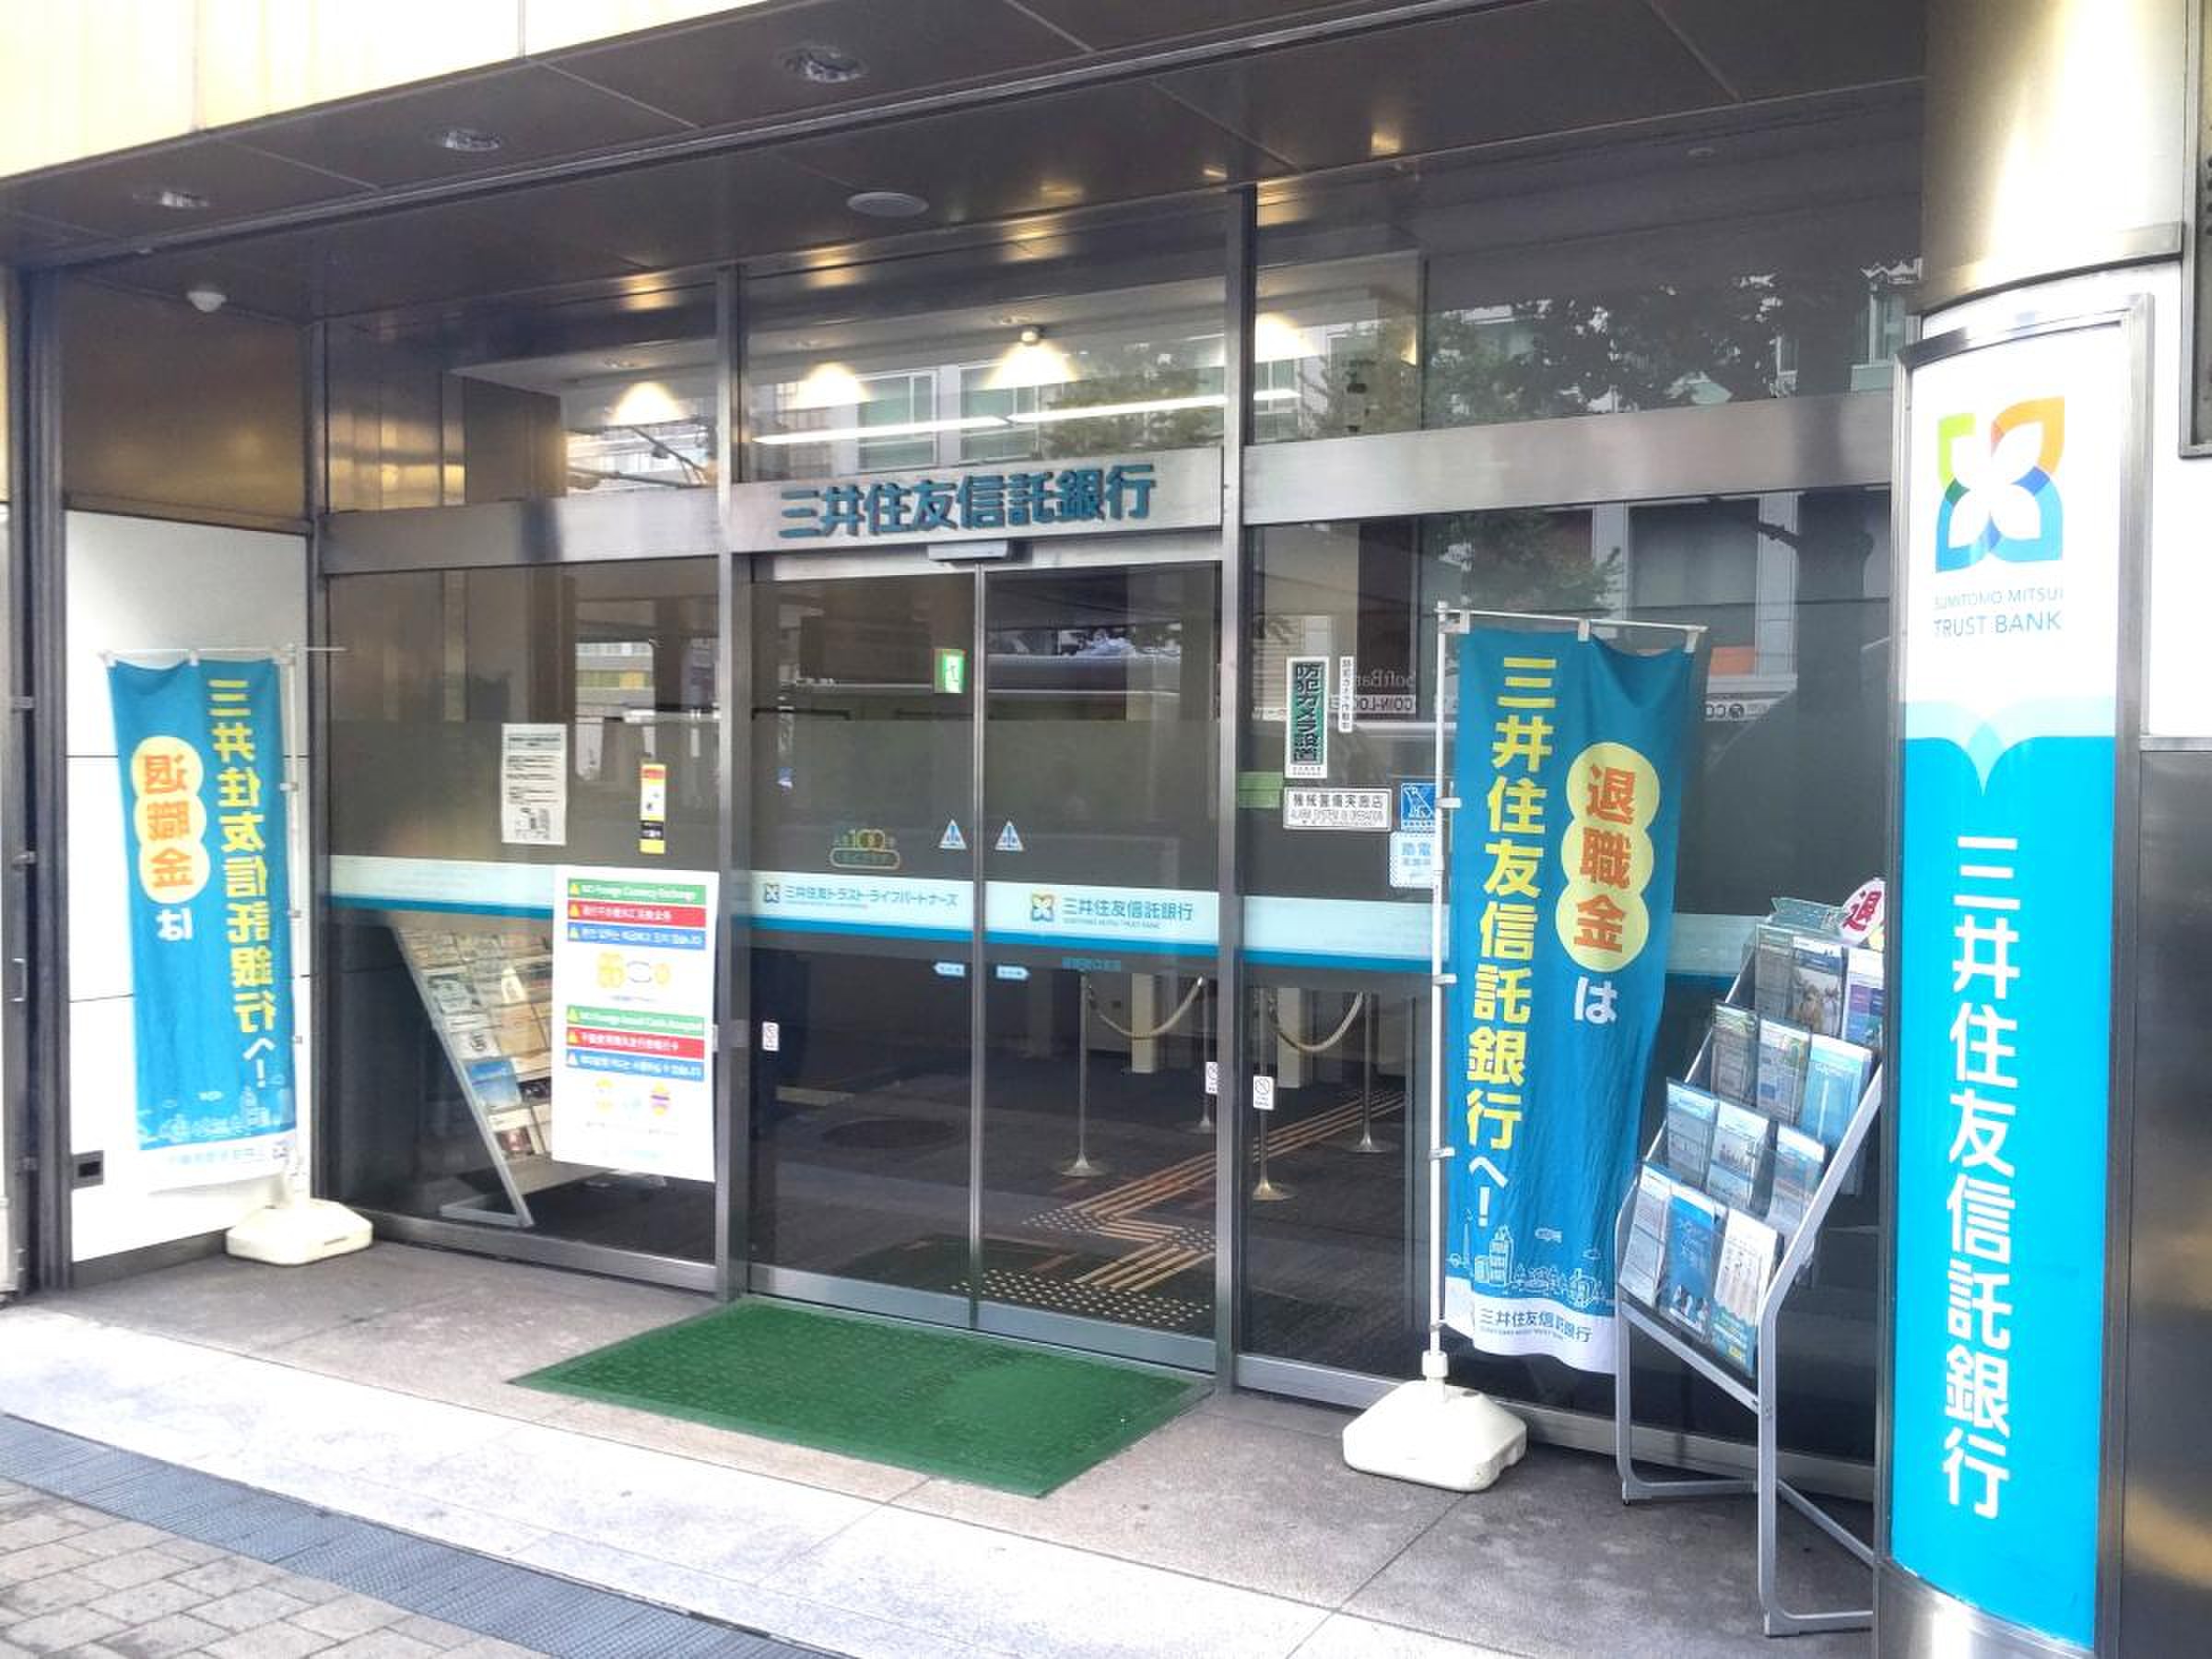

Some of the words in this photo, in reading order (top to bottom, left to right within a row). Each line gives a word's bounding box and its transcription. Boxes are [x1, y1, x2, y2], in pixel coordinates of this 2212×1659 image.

[779, 464, 1158, 538] 三井住友信託銀行
[2007, 586, 2064, 604] MITSUI
[1933, 616, 1987, 637] TRUST
[1994, 610, 2063, 634] BANK
[1063, 897, 1194, 921] 三井住友信託銀行
[1941, 835, 2021, 1521] 三井住友信託銀行
[1479, 1308, 1594, 1344] 三井住友信託銀行
